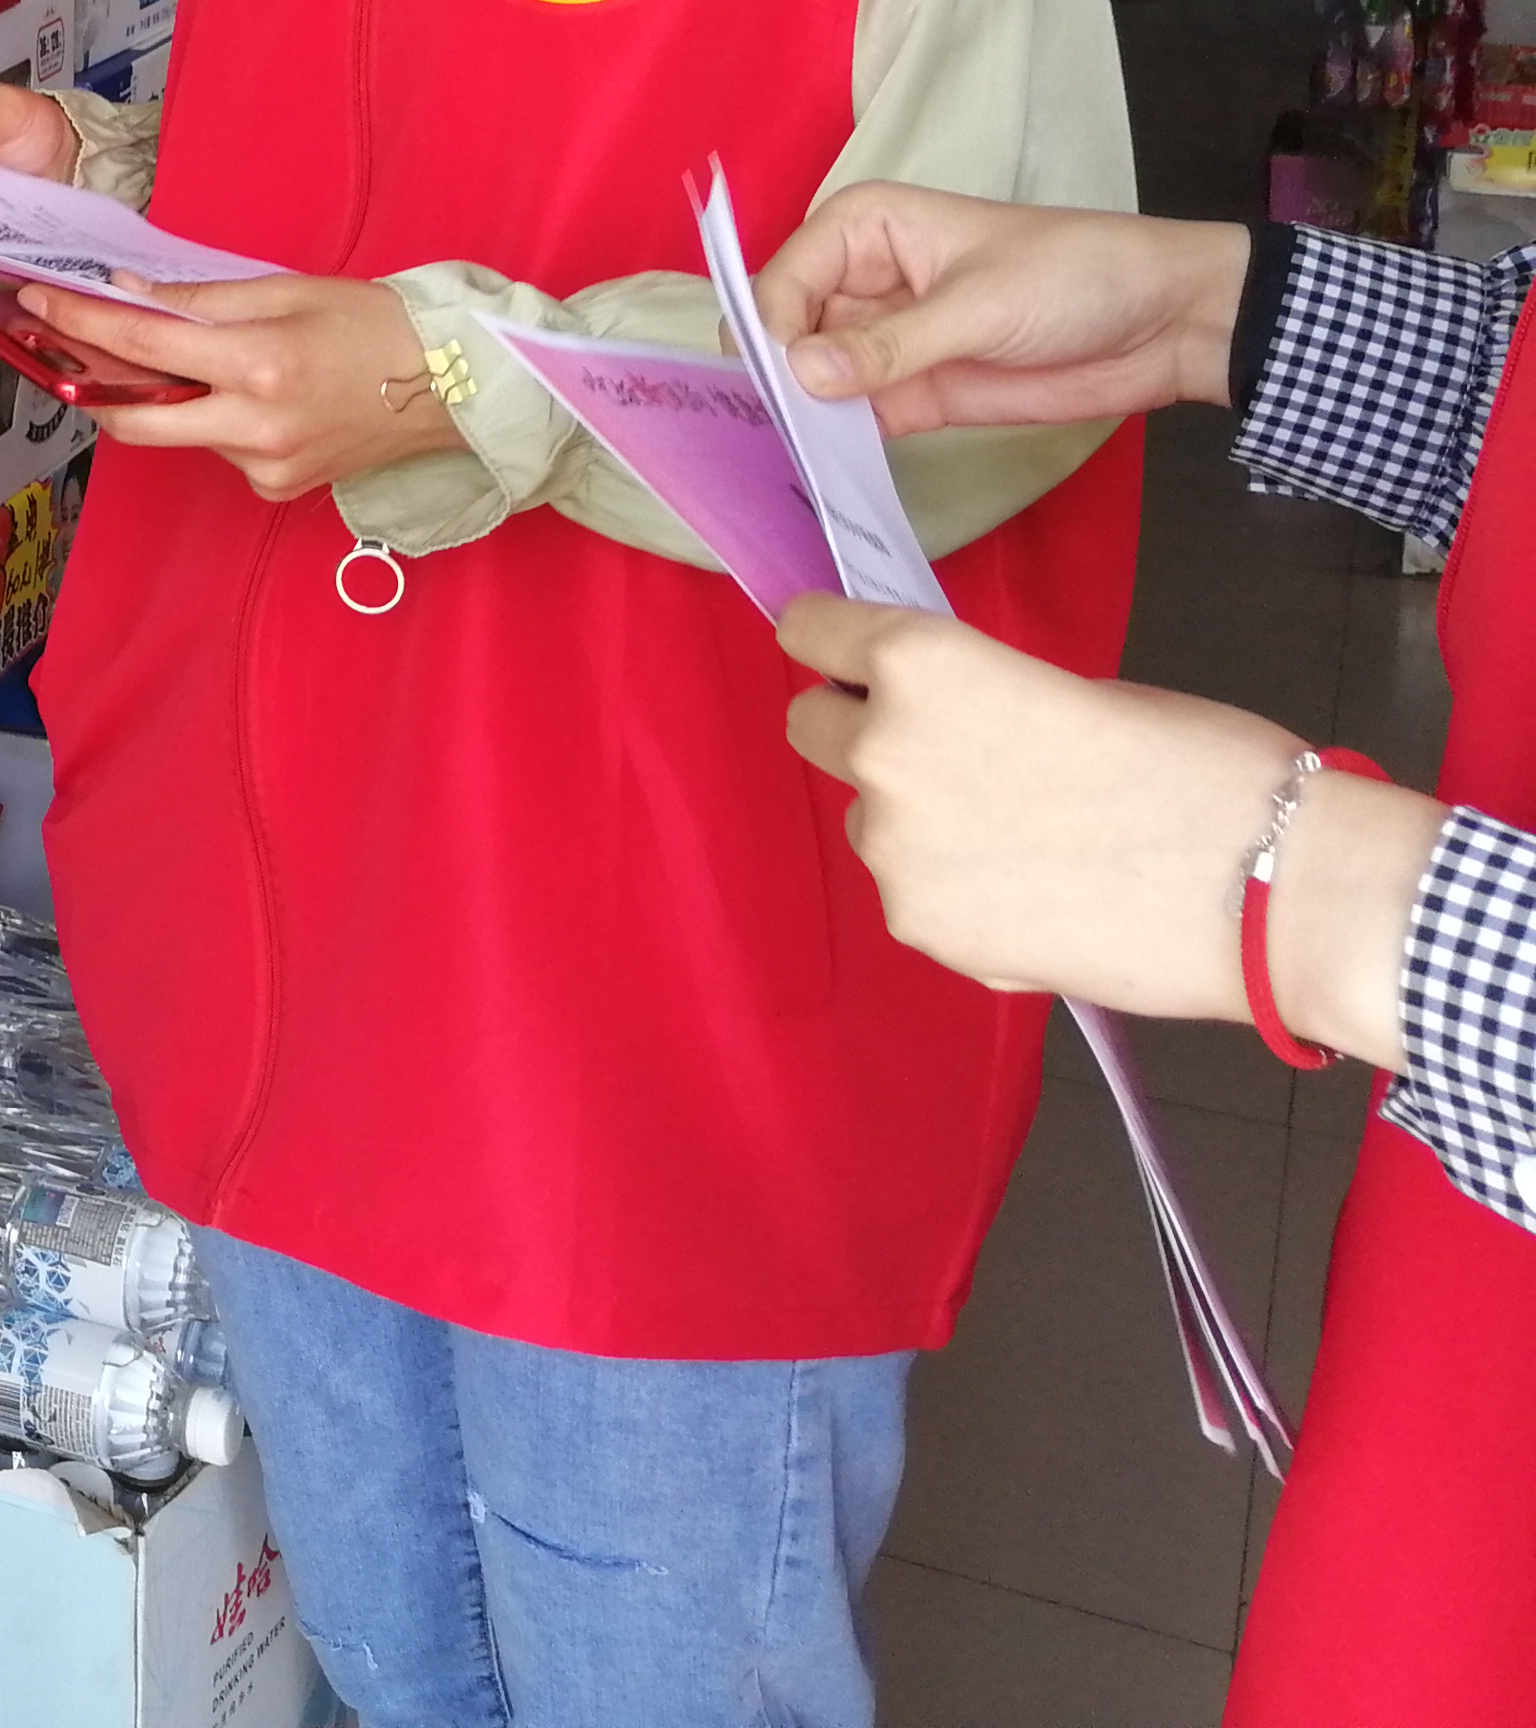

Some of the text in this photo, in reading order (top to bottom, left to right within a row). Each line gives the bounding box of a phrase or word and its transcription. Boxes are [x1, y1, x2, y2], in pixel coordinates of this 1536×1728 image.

[211, 1615, 287, 1714] DRINKING WATER
[212, 1631, 255, 1689] PURIFIED
